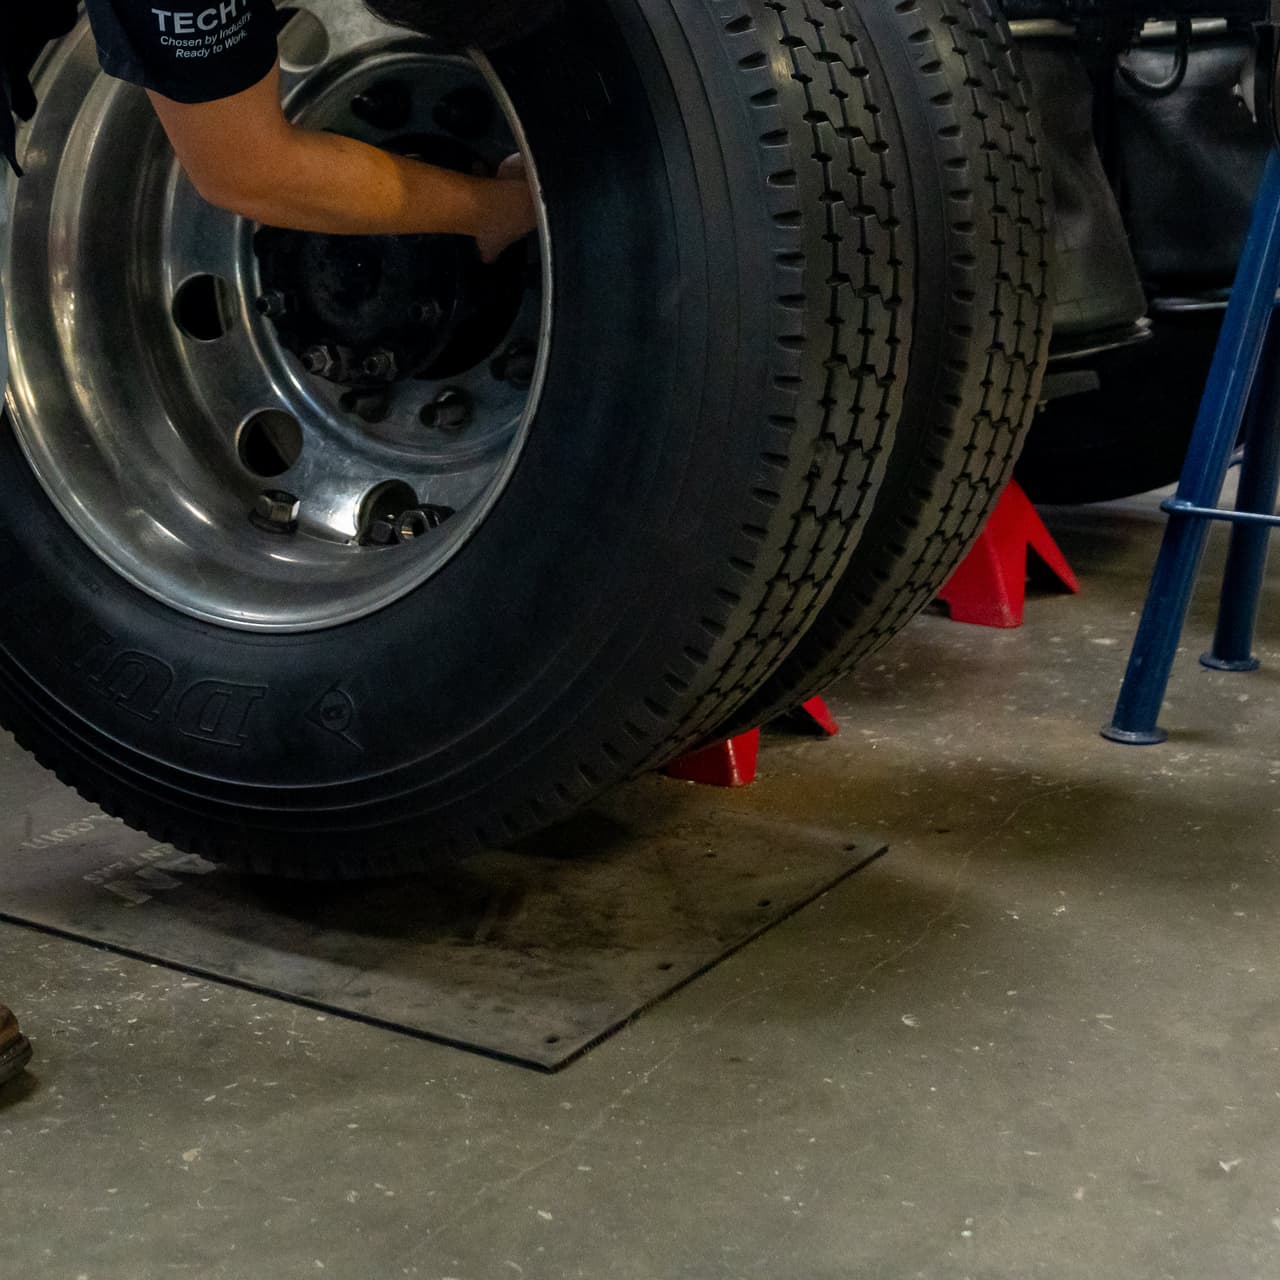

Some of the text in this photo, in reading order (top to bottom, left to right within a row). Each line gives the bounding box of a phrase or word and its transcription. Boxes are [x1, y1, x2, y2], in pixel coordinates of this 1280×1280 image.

[160, 35, 202, 47] Chosen
[205, 34, 217, 46] by
[175, 48, 210, 58] Ready
[212, 45, 223, 54] to
